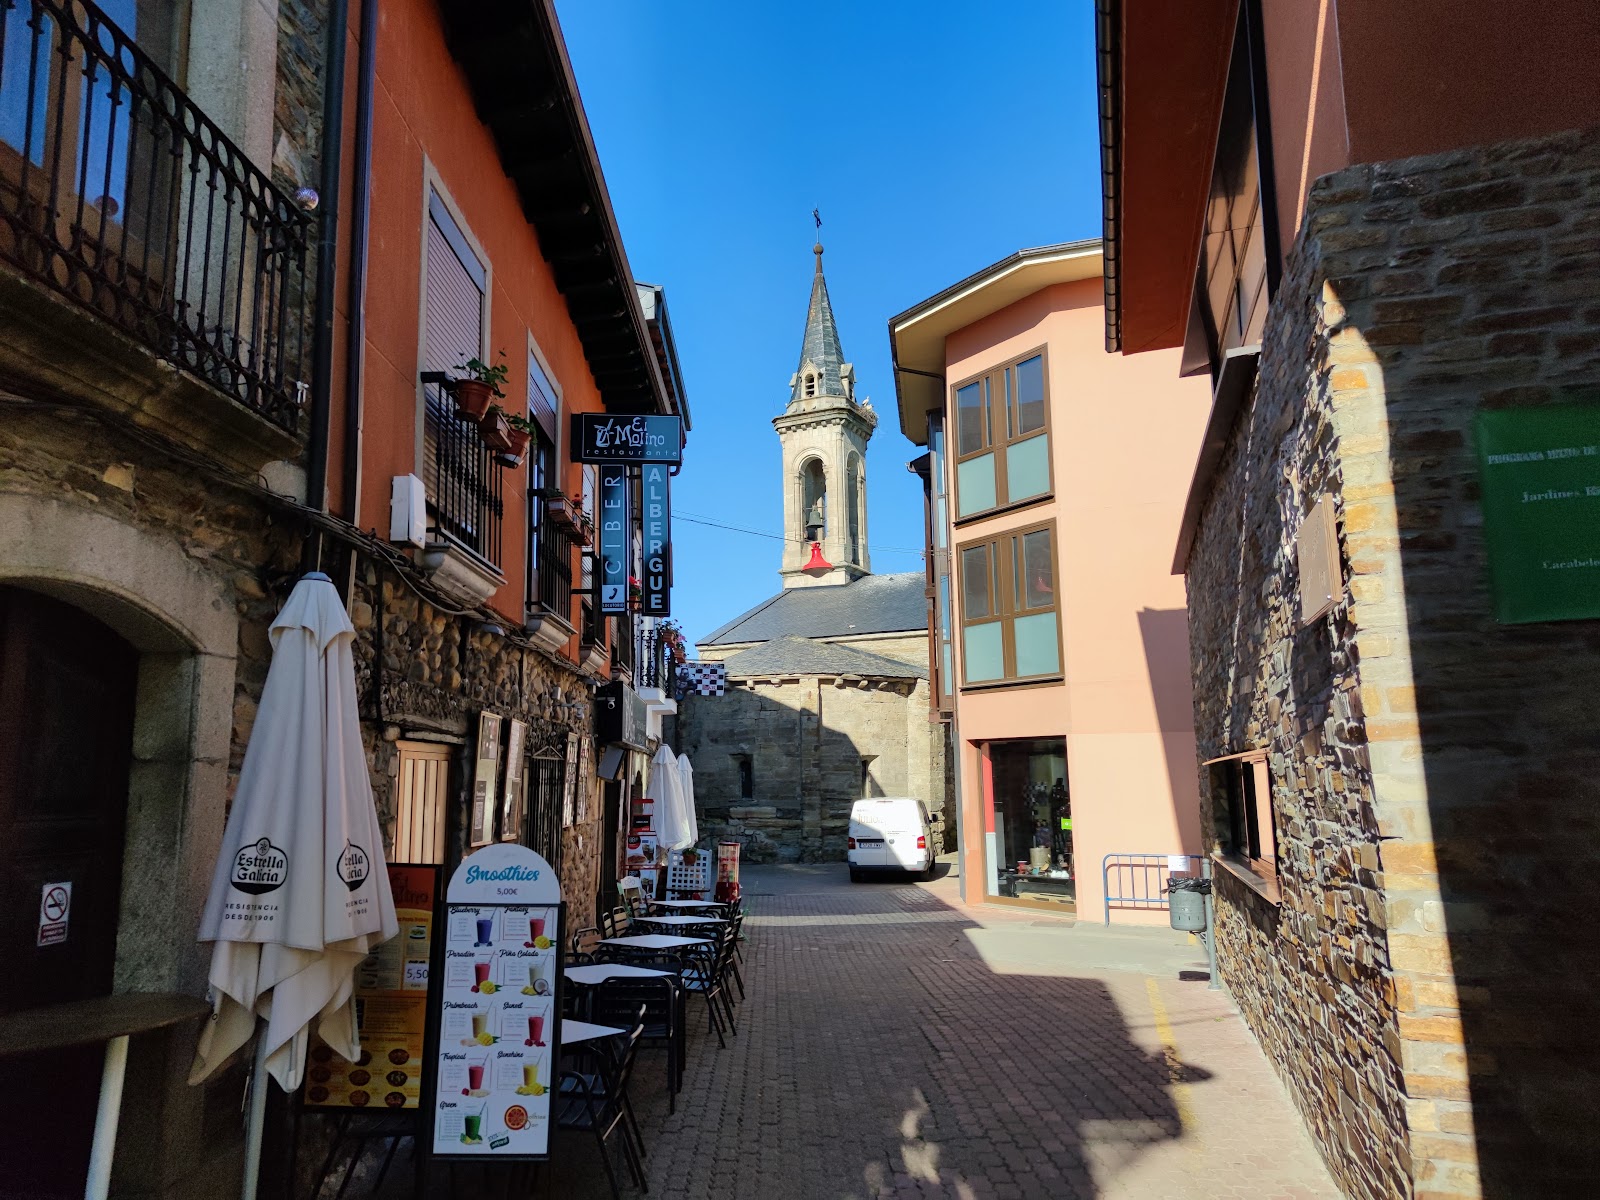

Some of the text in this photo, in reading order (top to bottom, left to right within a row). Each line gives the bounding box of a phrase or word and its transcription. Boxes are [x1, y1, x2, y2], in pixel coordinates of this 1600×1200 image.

[632, 417, 648, 432] El
[614, 425, 665, 447] Molino
[604, 475, 622, 575] CIBER
[648, 467, 664, 609] ALBERGUE
[237, 853, 284, 869] Estrella
[237, 867, 279, 883] Galicia
[465, 864, 540, 885] Smoothies
[496, 888, 518, 896] 5,00€
[225, 903, 279, 911] RESISTENCIA
[450, 906, 481, 916] Blueberry
[504, 906, 530, 915] Fantasy
[446, 950, 475, 958] Paradise
[517, 950, 539, 958] Colada
[406, 968, 429, 979] 5,50
[440, 1052, 467, 1061] Tropical
[497, 1051, 524, 1059] Sunshine
[439, 1101, 458, 1109] Green
